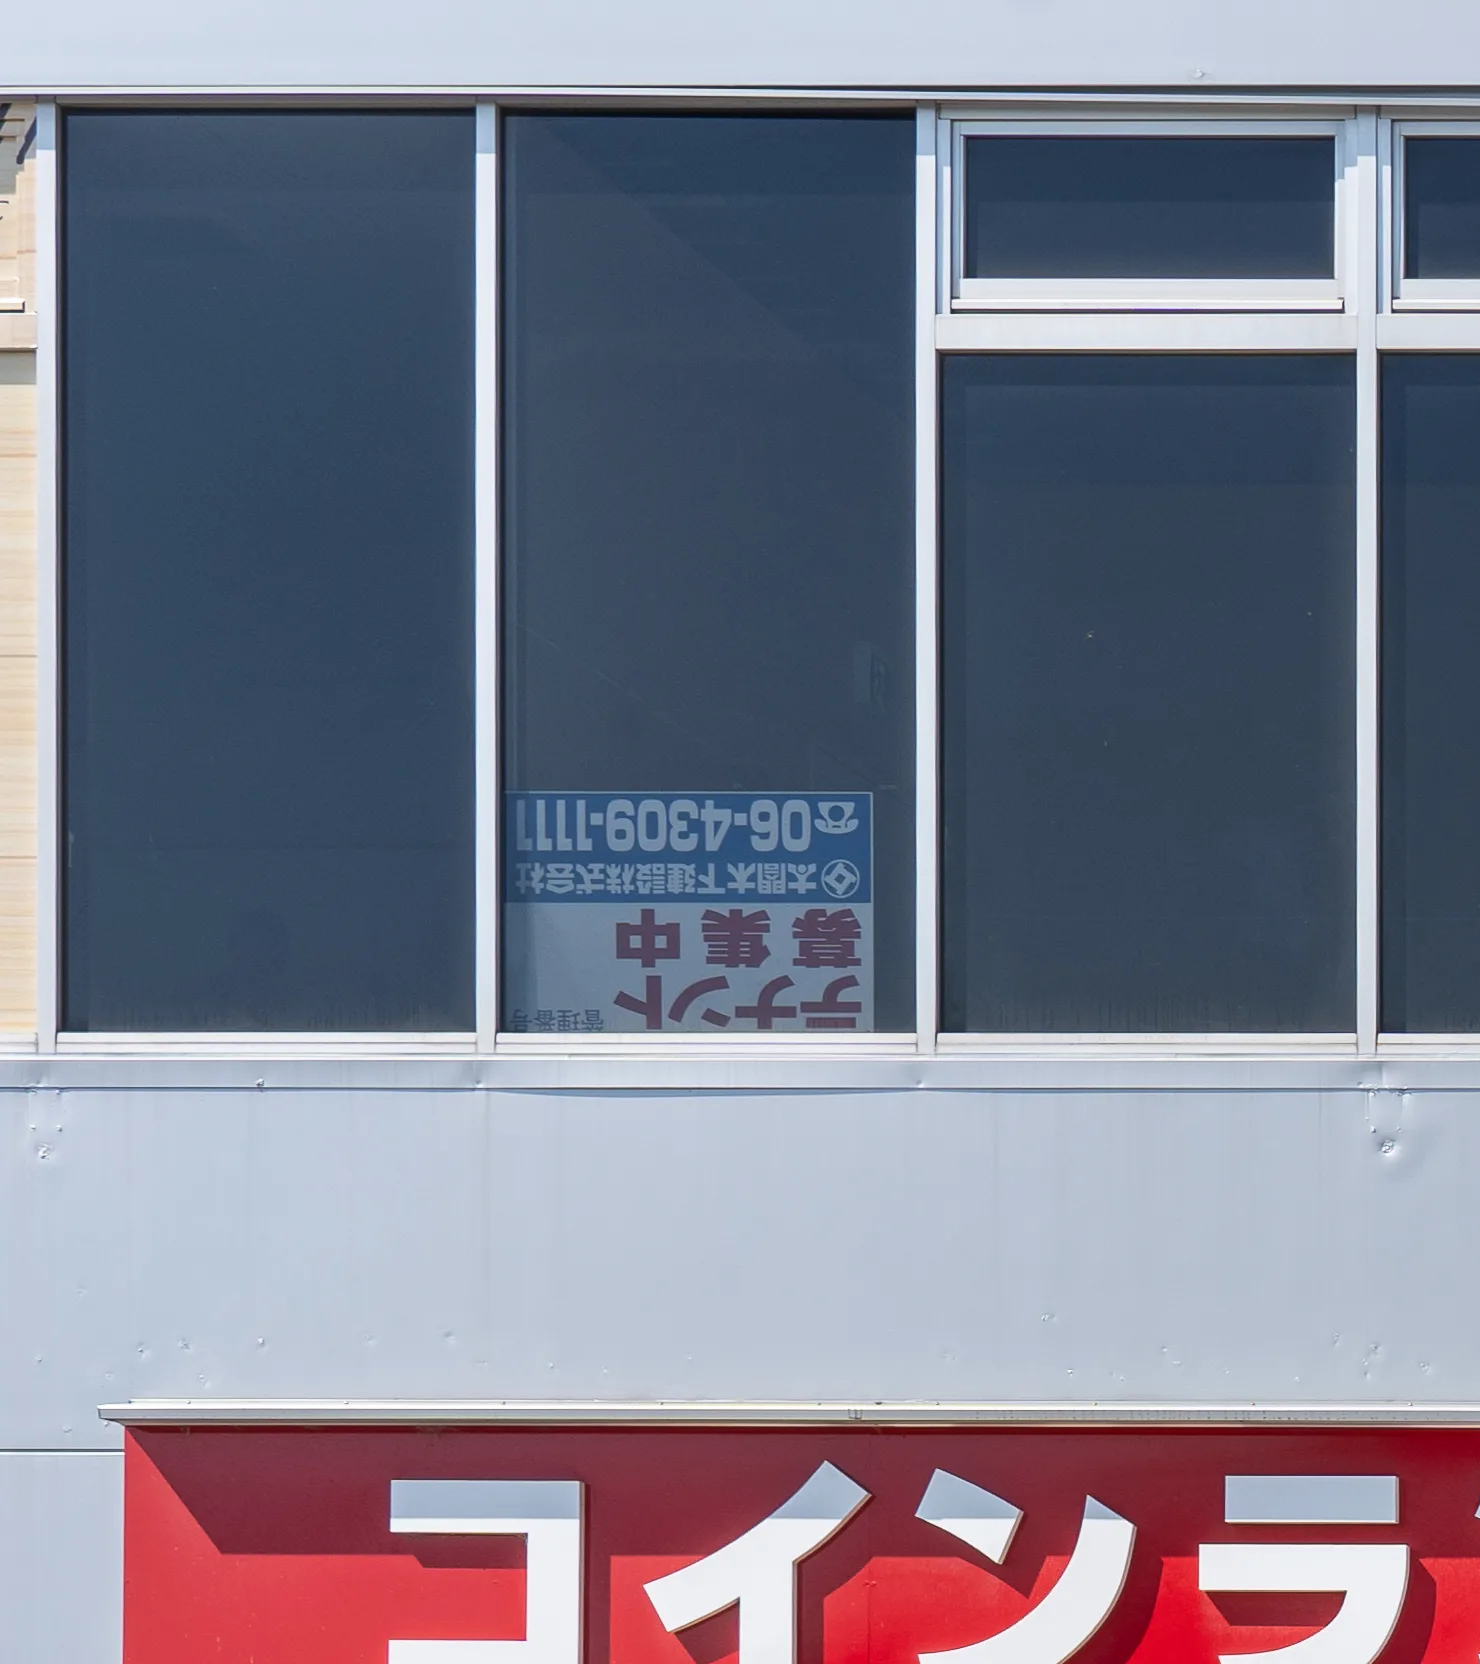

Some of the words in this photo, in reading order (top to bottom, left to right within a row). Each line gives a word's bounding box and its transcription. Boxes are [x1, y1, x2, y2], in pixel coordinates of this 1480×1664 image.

[515, 799, 811, 852] 06-4309-1111
[515, 863, 817, 894] 太閤木下建設株式会社
[616, 908, 862, 968] 募集中
[509, 1008, 604, 1033] 管理番号
[613, 974, 862, 1030] テナント
